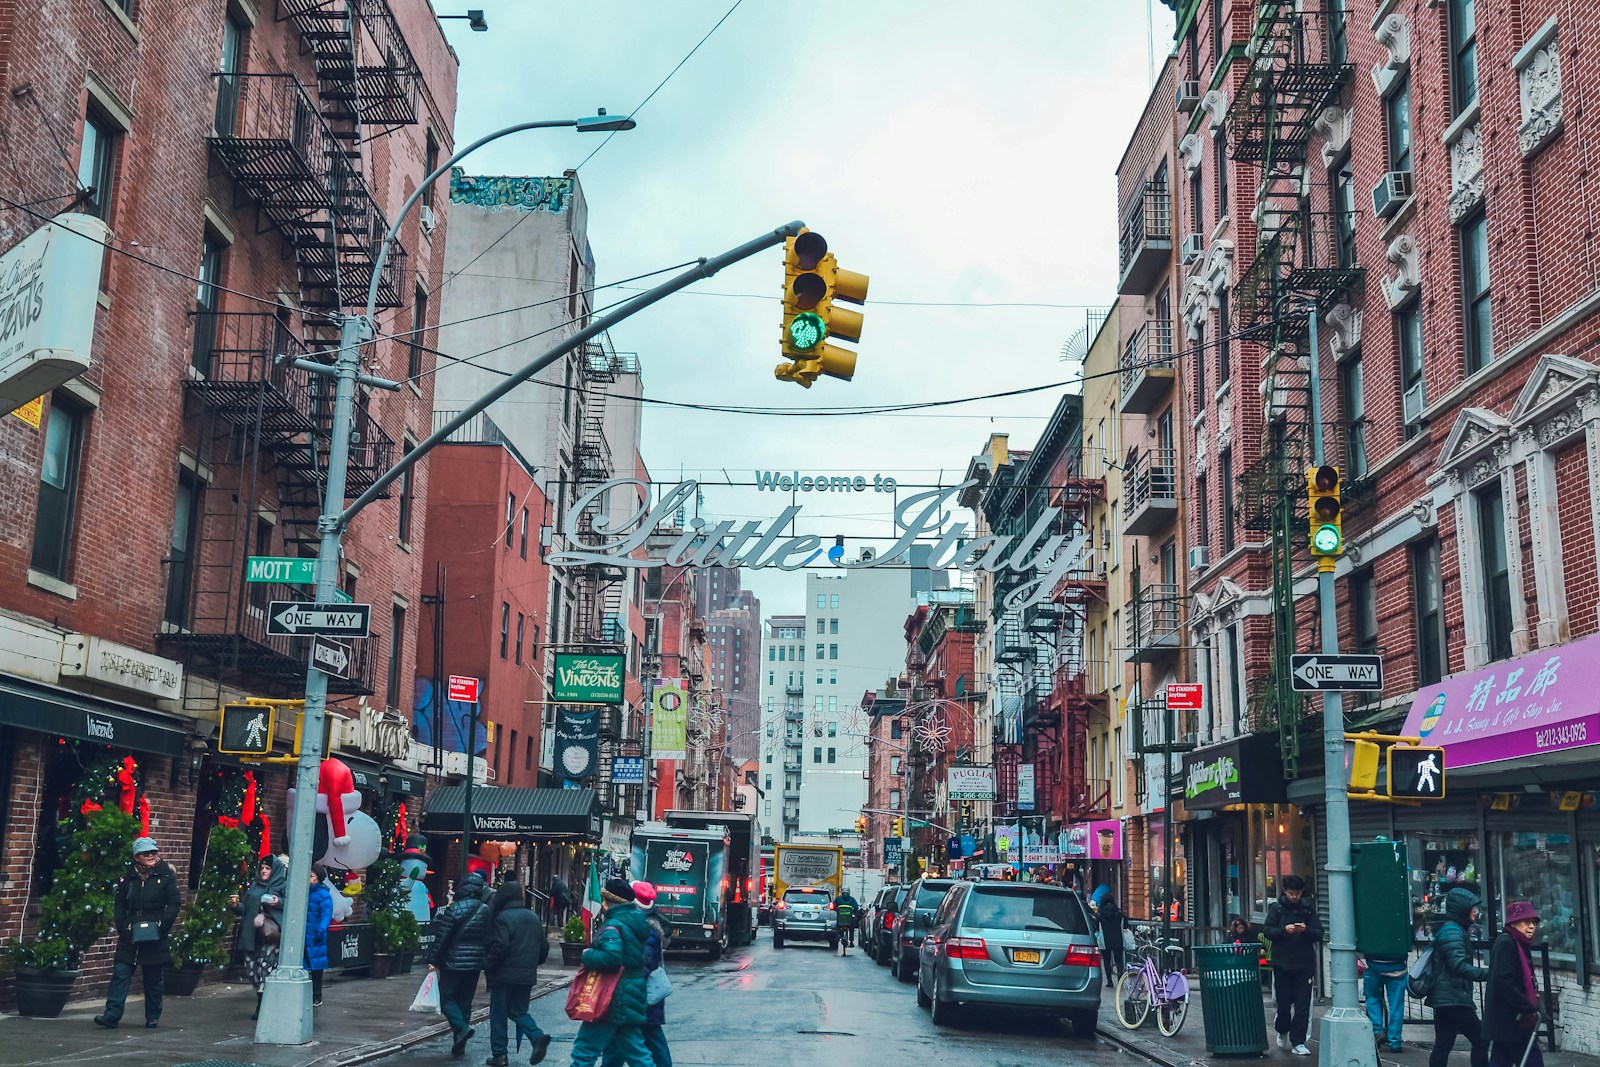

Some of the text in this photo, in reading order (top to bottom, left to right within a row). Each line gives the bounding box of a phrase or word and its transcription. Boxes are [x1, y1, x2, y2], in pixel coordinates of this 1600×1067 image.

[7, 240, 50, 301] Original
[755, 470, 897, 493] Welcome to
[545, 478, 1097, 611] Little Italy
[251, 561, 313, 579] MOTT ST
[285, 613, 356, 626] ONE WAY
[318, 646, 344, 667] ONE WAY
[572, 660, 618, 675] The Original
[1305, 666, 1374, 679] ONE WAY
[1465, 655, 1562, 712] 精品廊
[1444, 720, 1453, 736] J.
[1454, 718, 1464, 733] J.
[1503, 707, 1519, 726] Gift
[1523, 702, 1543, 719] Shop
[953, 769, 993, 780] PUGLIA
[666, 850, 686, 858] Safety
